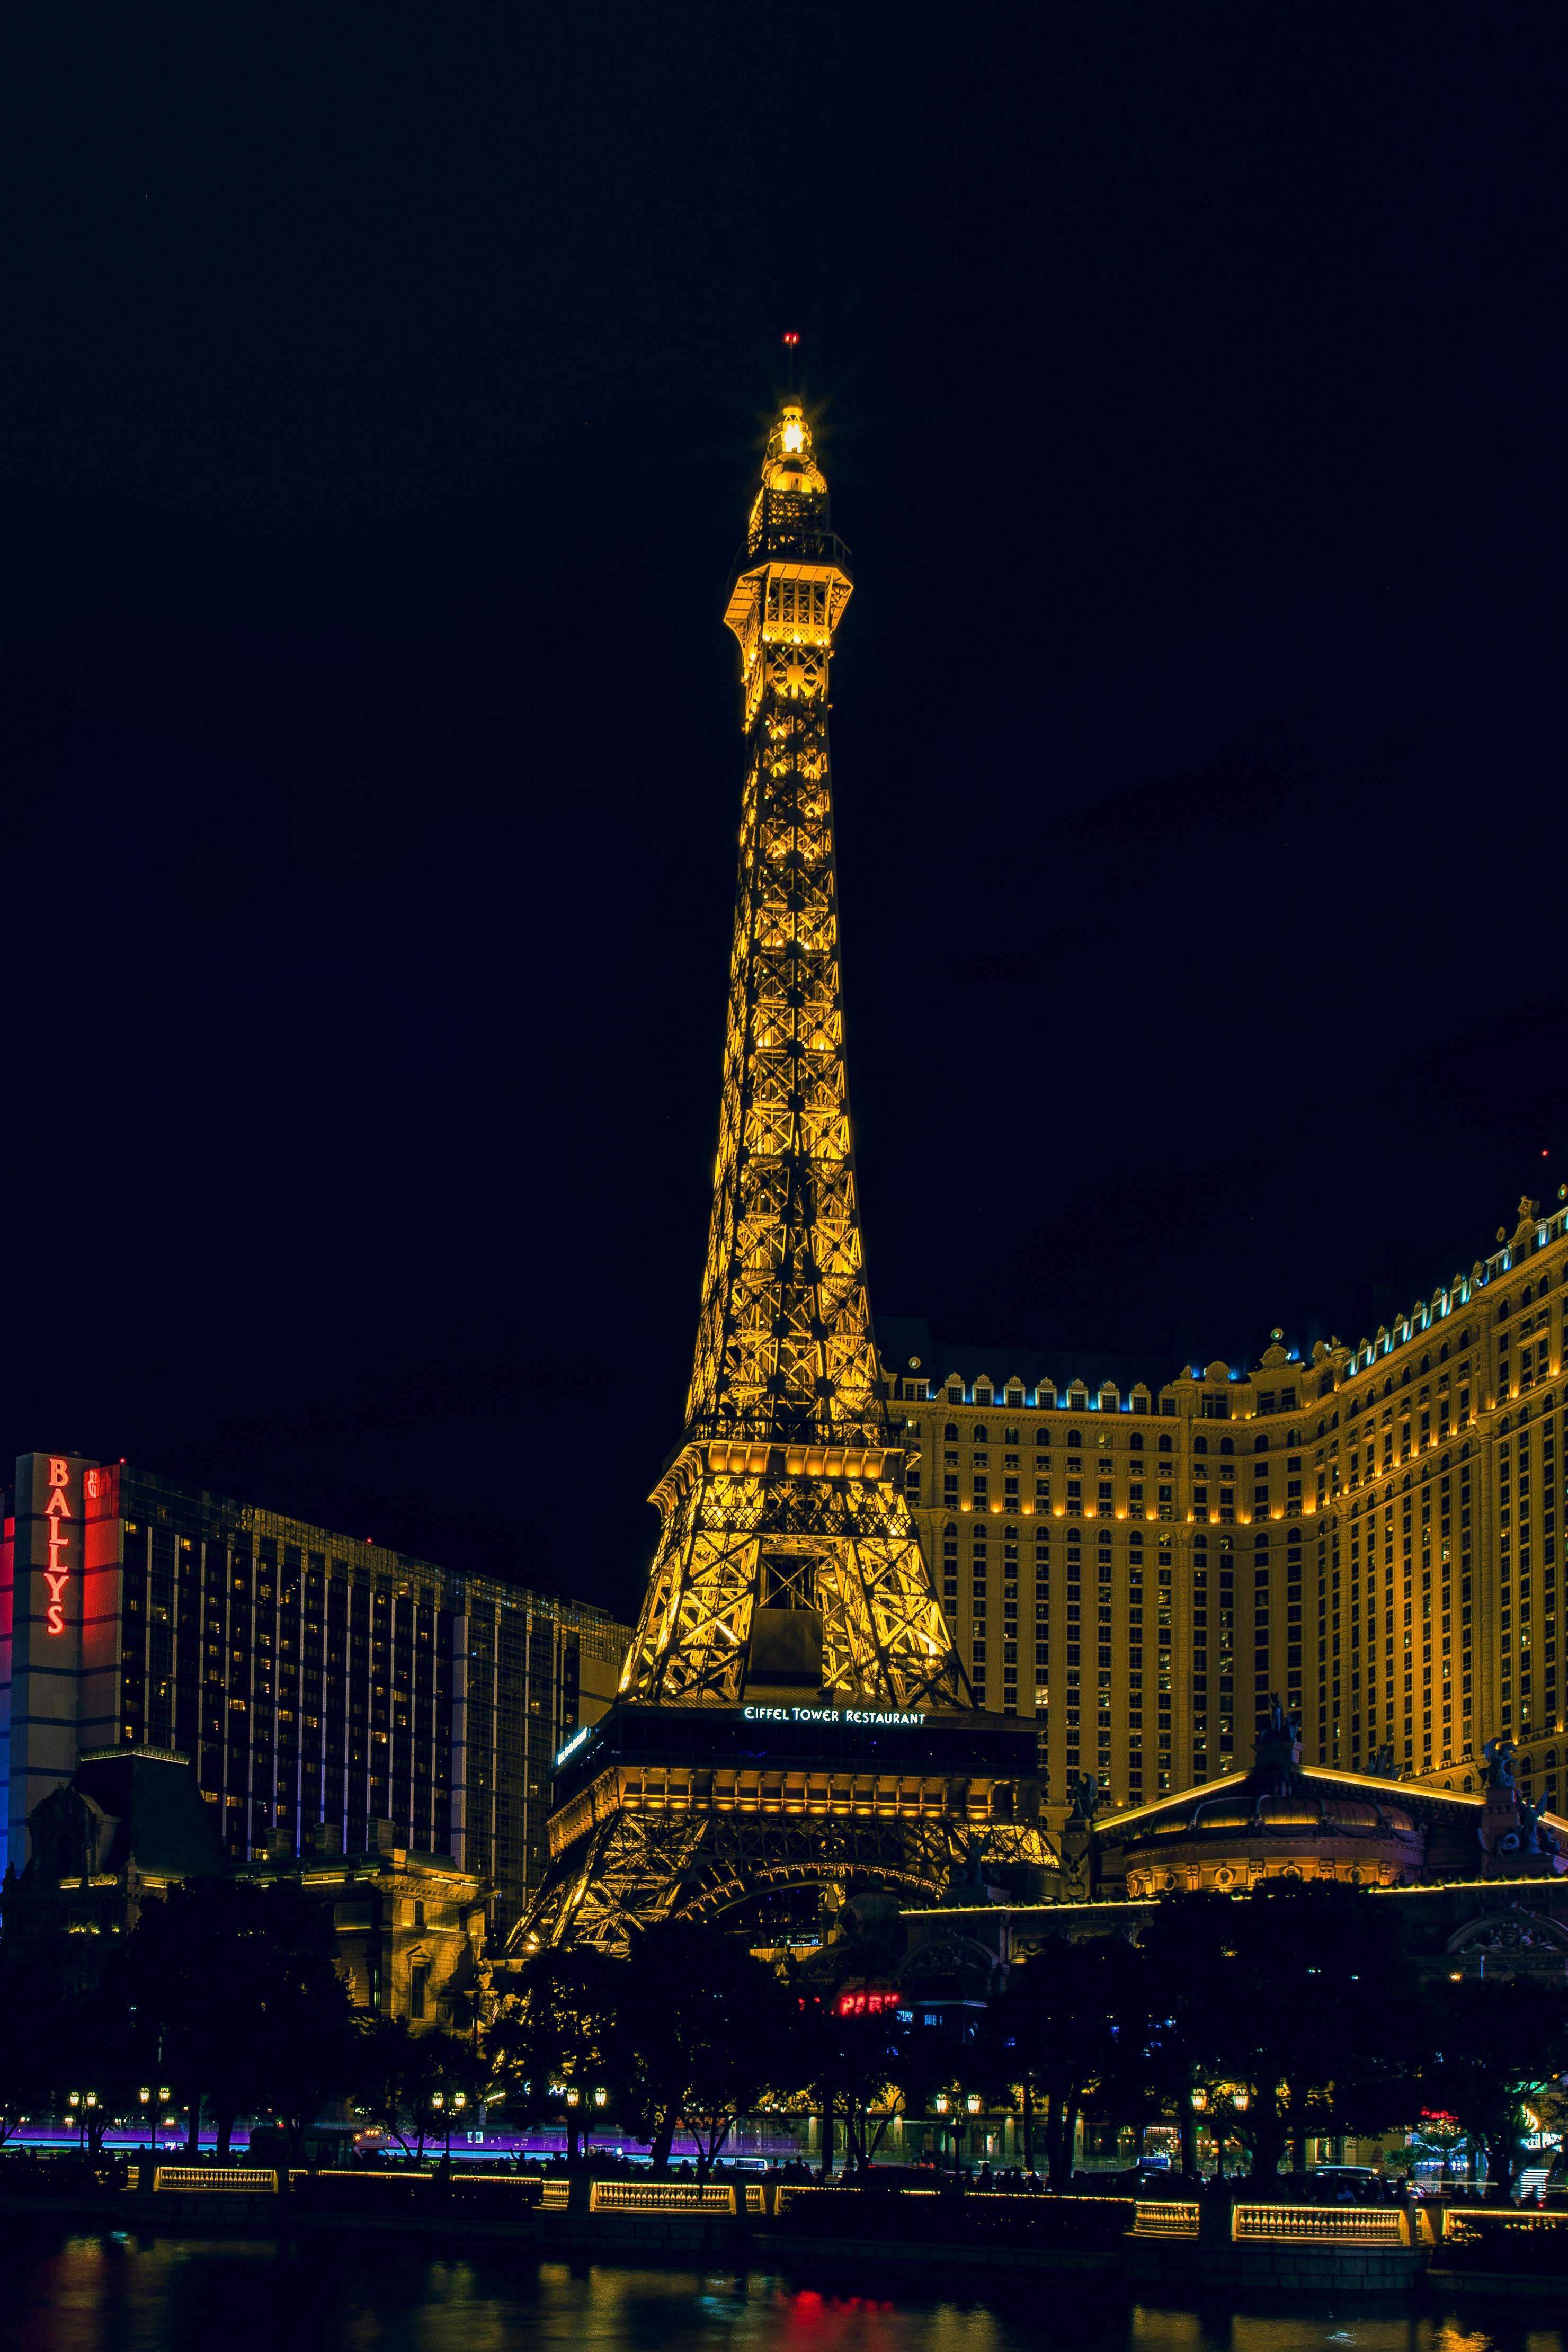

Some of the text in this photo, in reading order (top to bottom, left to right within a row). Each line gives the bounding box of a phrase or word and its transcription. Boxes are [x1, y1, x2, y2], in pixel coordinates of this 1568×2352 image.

[44, 1458, 72, 1634] BALLYS
[744, 1706, 925, 1725] EIFFEL TOWER RESTAURANT
